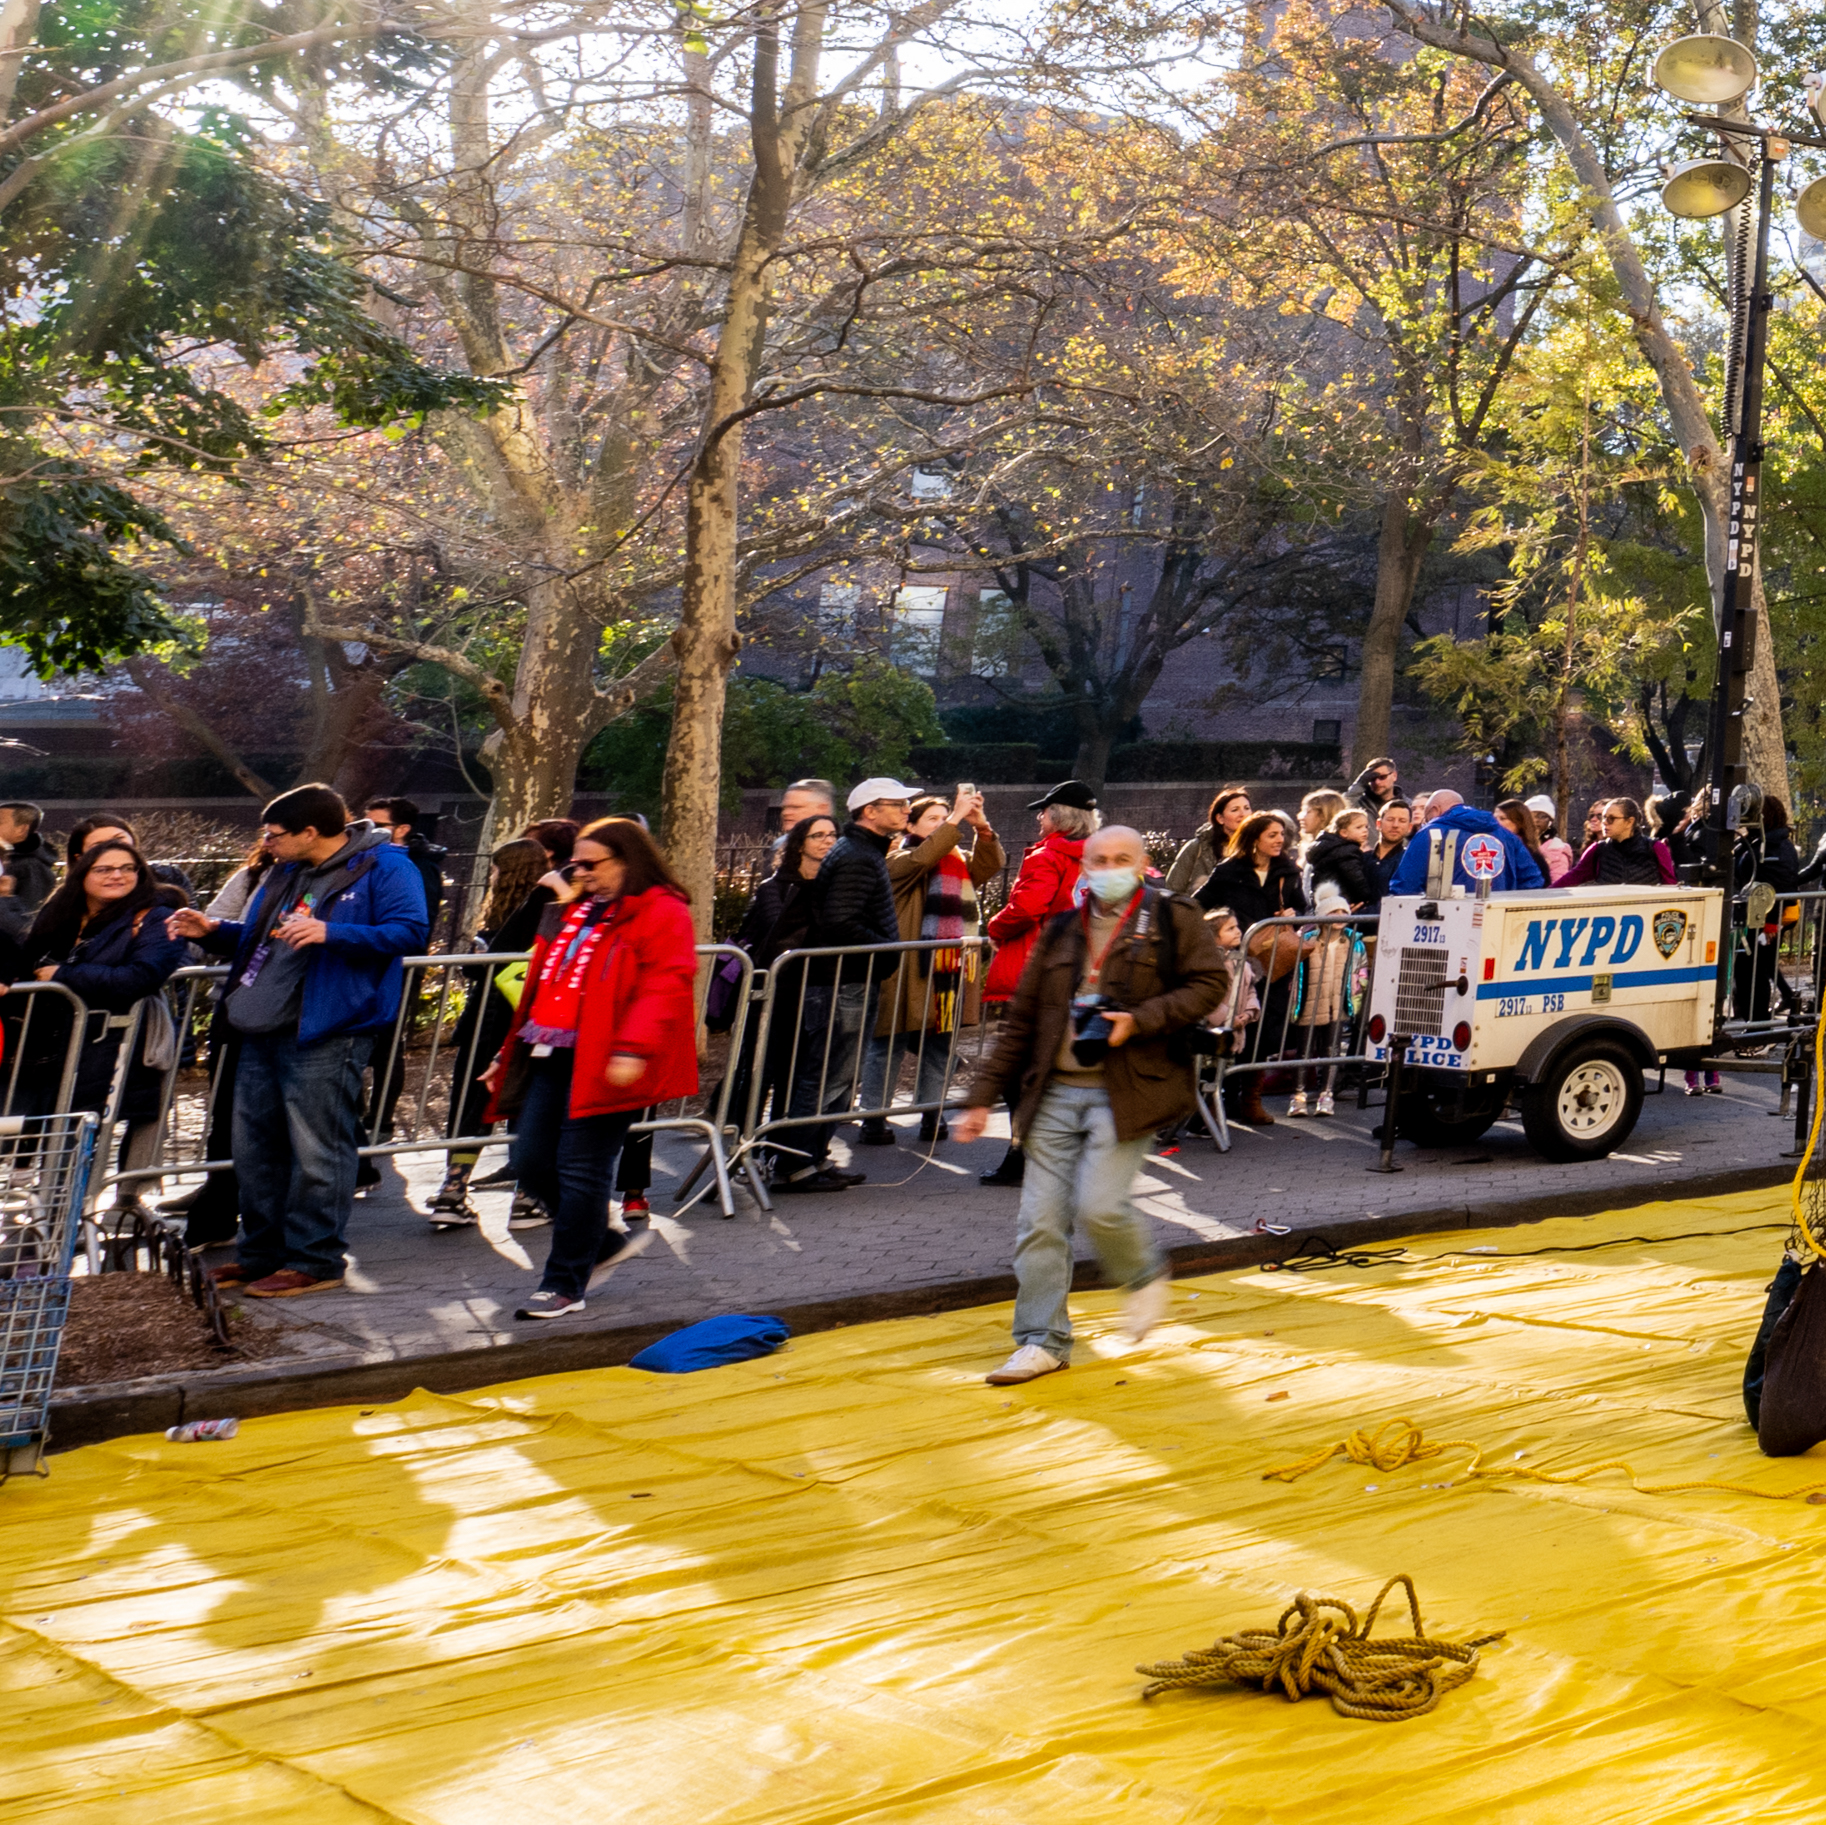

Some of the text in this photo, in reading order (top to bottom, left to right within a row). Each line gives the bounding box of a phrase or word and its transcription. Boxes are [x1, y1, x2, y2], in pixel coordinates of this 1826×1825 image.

[1730, 463, 1744, 534] NYPD
[1739, 504, 1757, 577] NYPD
[1413, 925, 1440, 943] 2917
[1513, 915, 1644, 972] NYPD
[1499, 998, 1526, 1017] 2917
[1542, 994, 1565, 1013] PSB
[1387, 1033, 1452, 1051] YPD
[1375, 1047, 1462, 1068] PLICE
